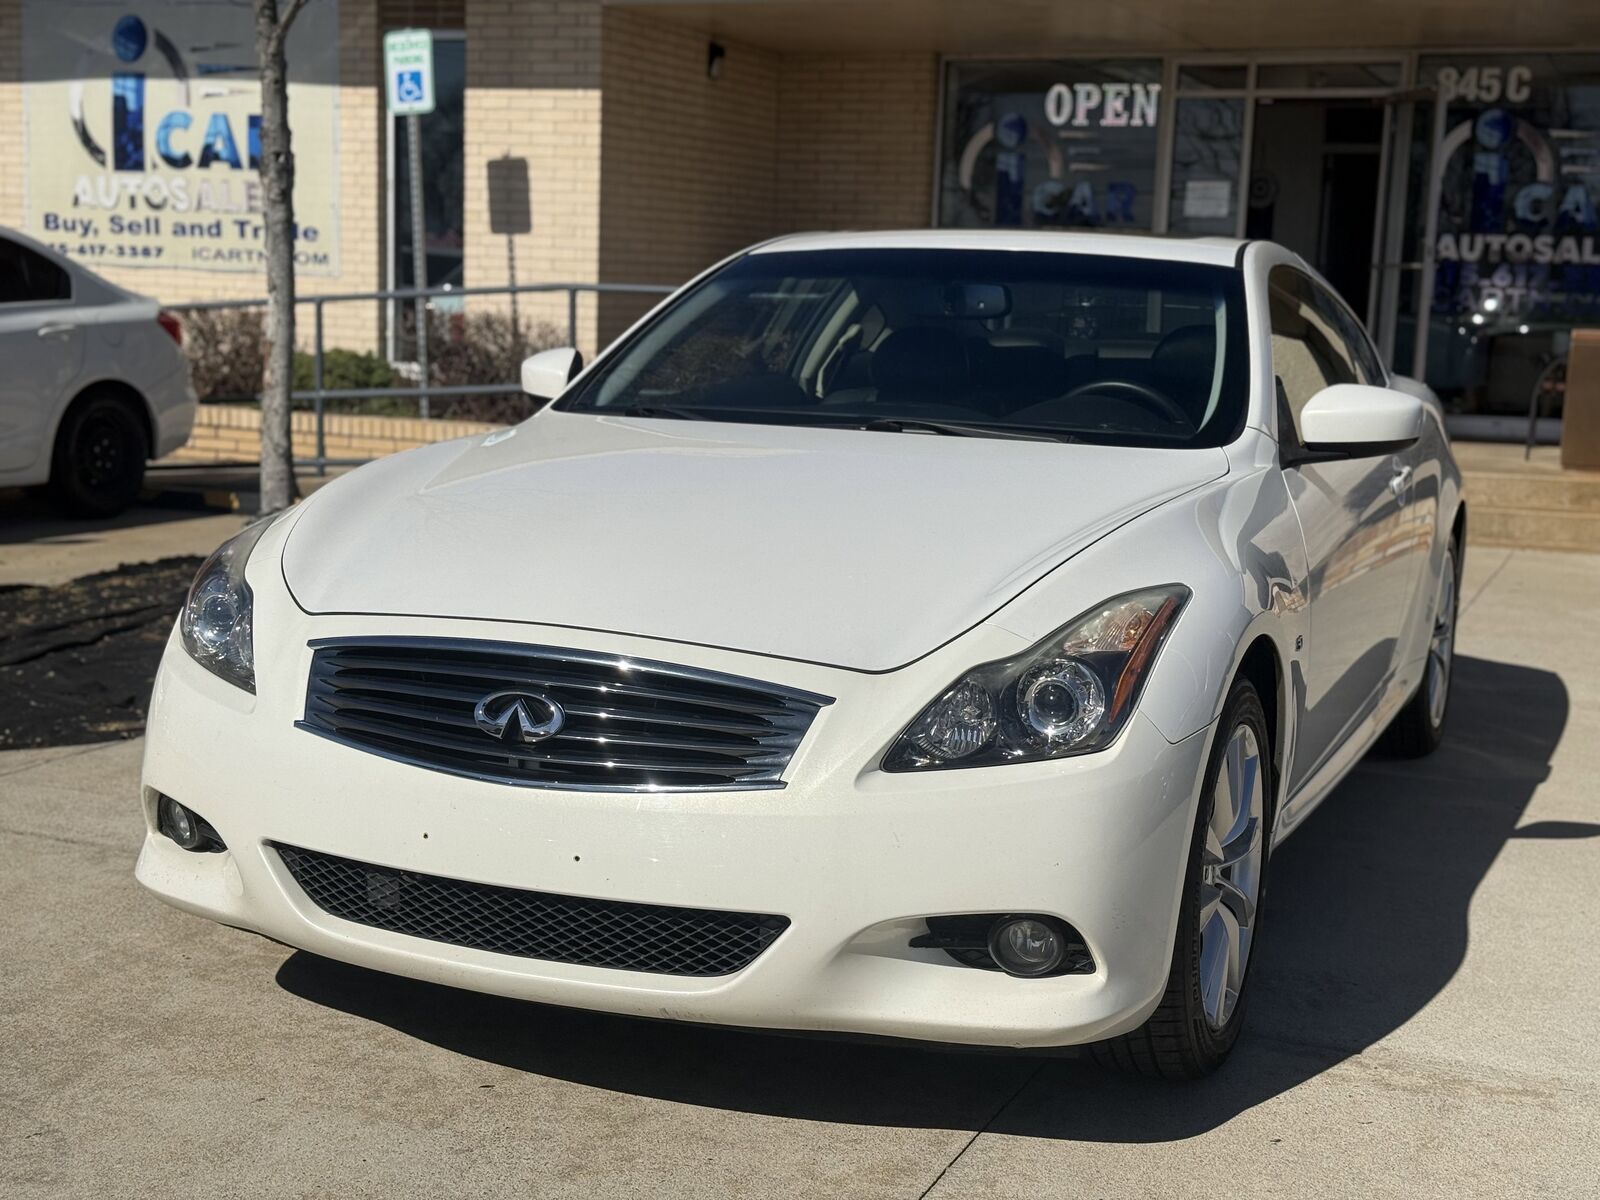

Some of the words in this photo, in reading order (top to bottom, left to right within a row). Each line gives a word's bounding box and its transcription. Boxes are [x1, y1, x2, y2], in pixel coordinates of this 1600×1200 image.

[1506, 65, 1533, 102] C
[1044, 83, 1161, 127] OPEN
[73, 176, 265, 213] AUTOSALE
[44, 213, 99, 237] Buy,
[110, 215, 160, 236] Sell
[172, 221, 222, 238] and
[233, 219, 319, 242] Tre
[191, 246, 329, 266] ICARTNOM
[1436, 233, 1600, 264] AUTOSAL
